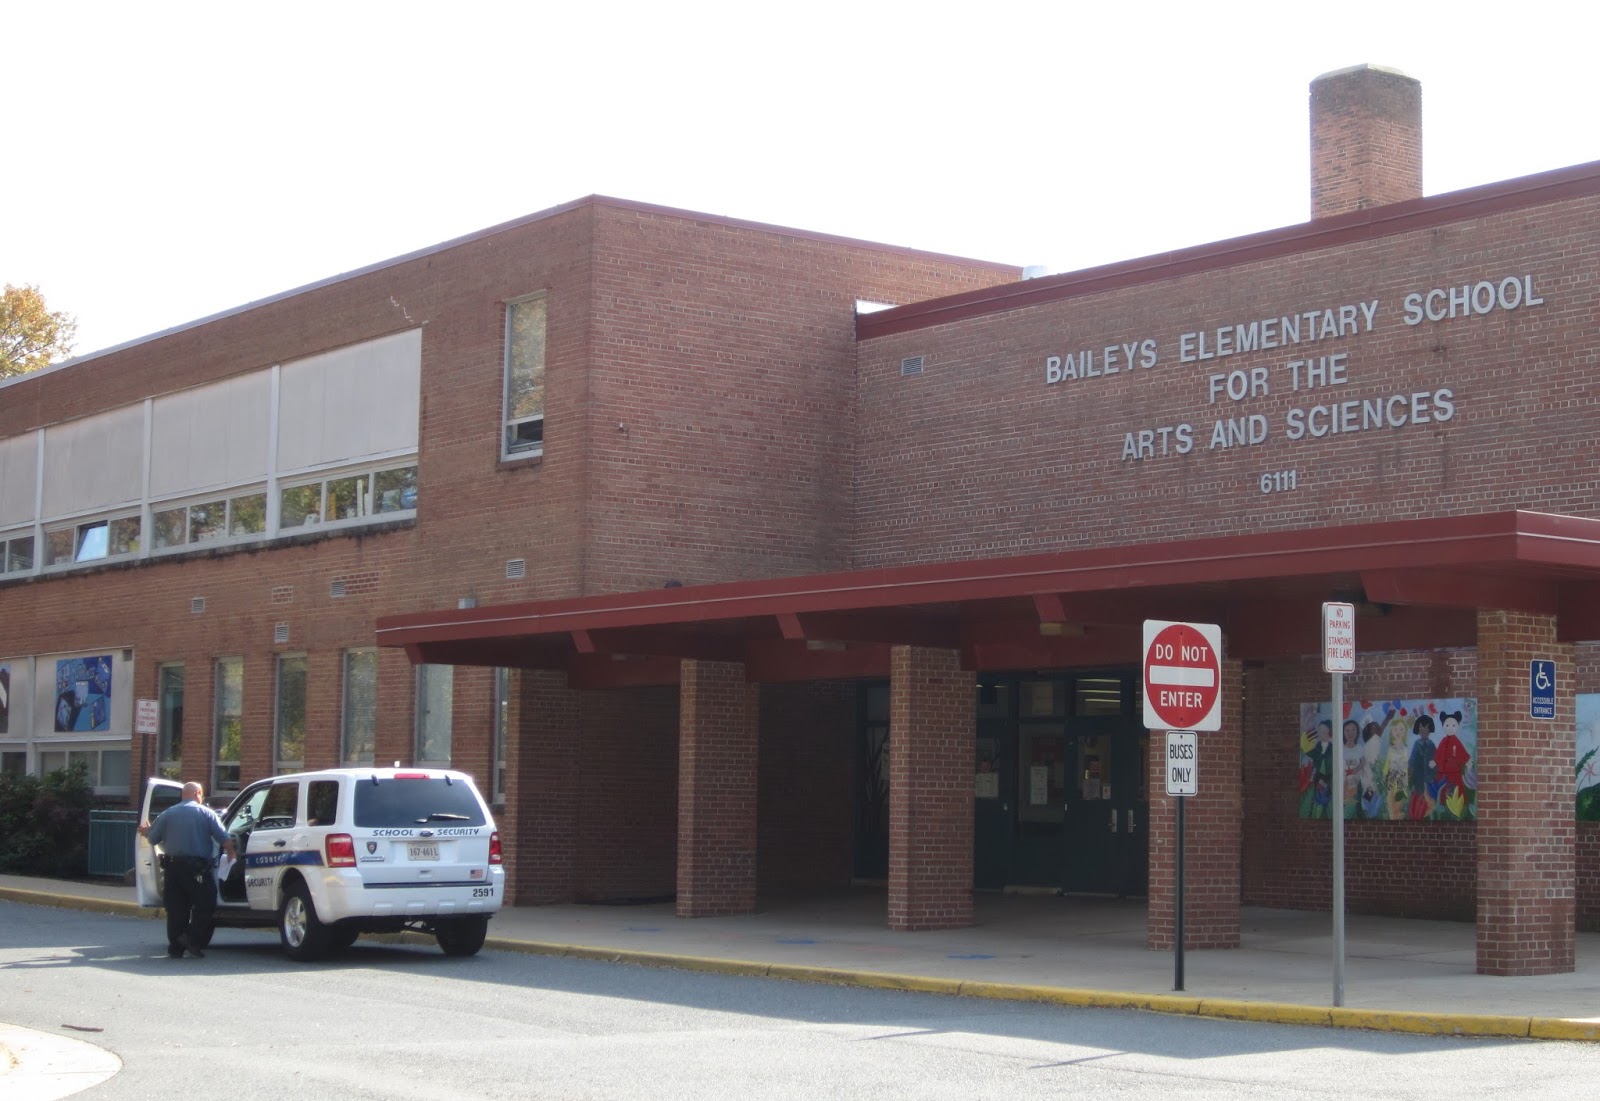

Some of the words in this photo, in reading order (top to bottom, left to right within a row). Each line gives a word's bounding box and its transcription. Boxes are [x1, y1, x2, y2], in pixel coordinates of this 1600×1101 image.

[1046, 339, 1157, 385] BAILEYS
[1180, 300, 1378, 363] ELEMENTARY
[1403, 274, 1544, 326] SCHOOL
[1209, 366, 1269, 404] FOR
[1286, 353, 1348, 391] THE
[1121, 423, 1193, 461] ARTS
[1210, 413, 1268, 450] AND
[1286, 388, 1455, 440] SCIENCES
[1260, 469, 1298, 494] 6111
[1336, 608, 1343, 618] NO
[1330, 620, 1350, 630] PARKING
[1329, 636, 1352, 646] STANDING
[1156, 643, 1173, 660] DO
[1182, 646, 1207, 662] NOT
[1328, 648, 1339, 658] FIRE
[1340, 648, 1352, 659] LANE
[1160, 691, 1202, 708] ENTER
[1532, 696, 1554, 704] ACCESSIBLE
[1533, 707, 1553, 715] ENTRANCE
[1169, 744, 1193, 760] BUSES
[1172, 767, 1191, 783] ONLY
[372, 829, 414, 837] SCHOOL
[437, 828, 480, 836] SECURITY
[247, 877, 273, 887] SECURITY
[472, 888, 494, 897] 2591
